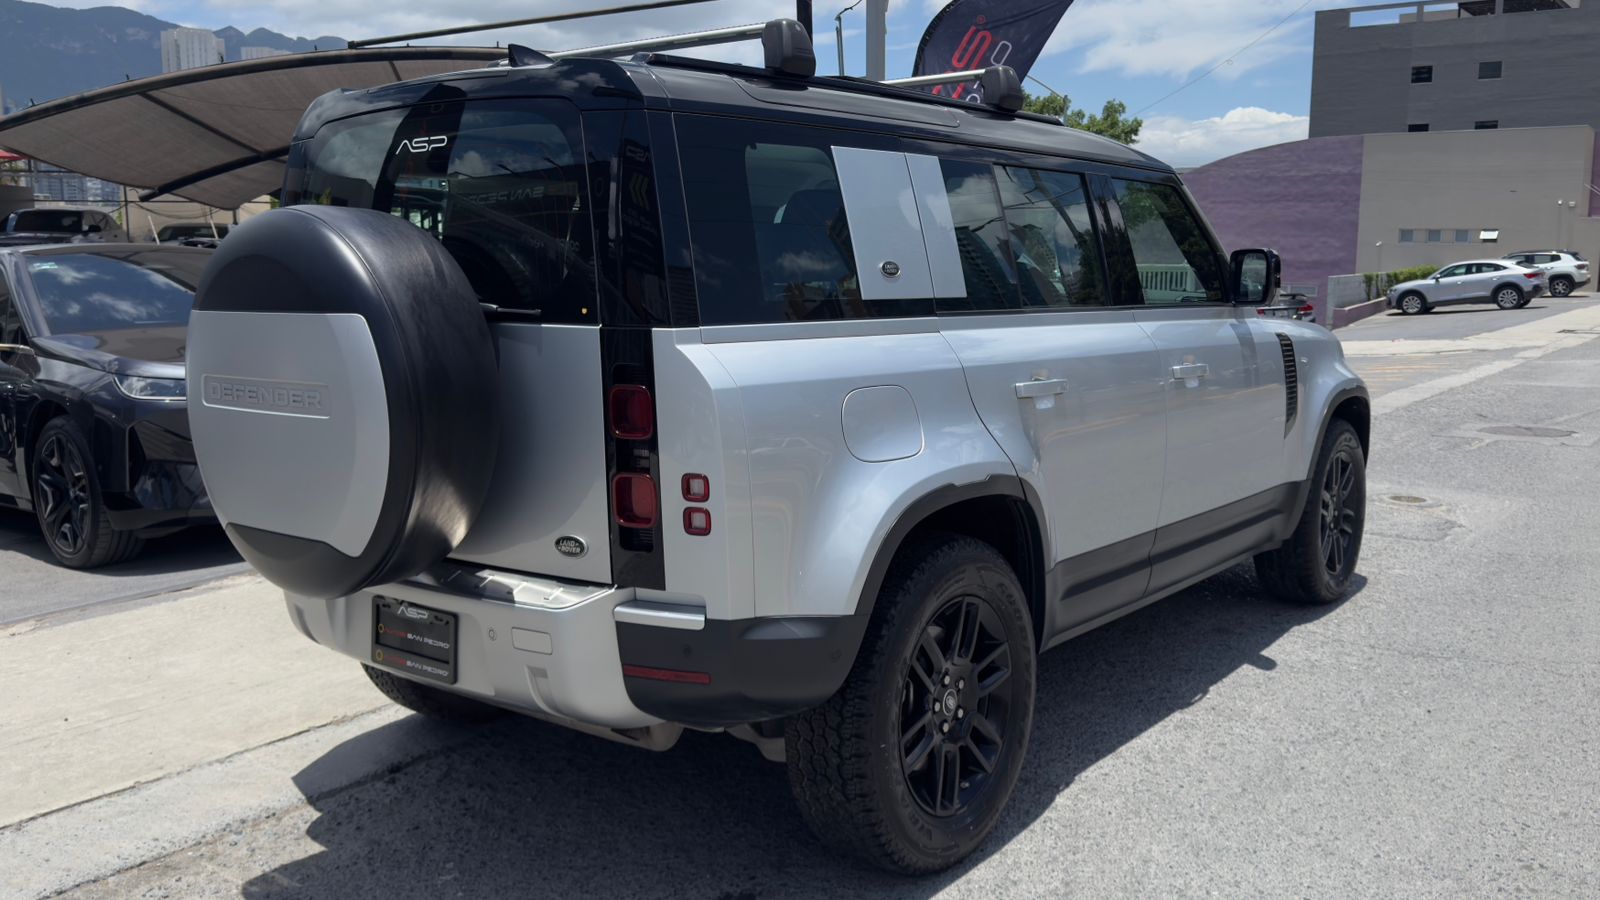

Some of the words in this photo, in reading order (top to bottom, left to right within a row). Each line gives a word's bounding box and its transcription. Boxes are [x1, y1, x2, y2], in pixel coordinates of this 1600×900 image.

[395, 135, 448, 155] ASP
[206, 382, 321, 408] DEFENDER
[397, 605, 429, 619] ASP
